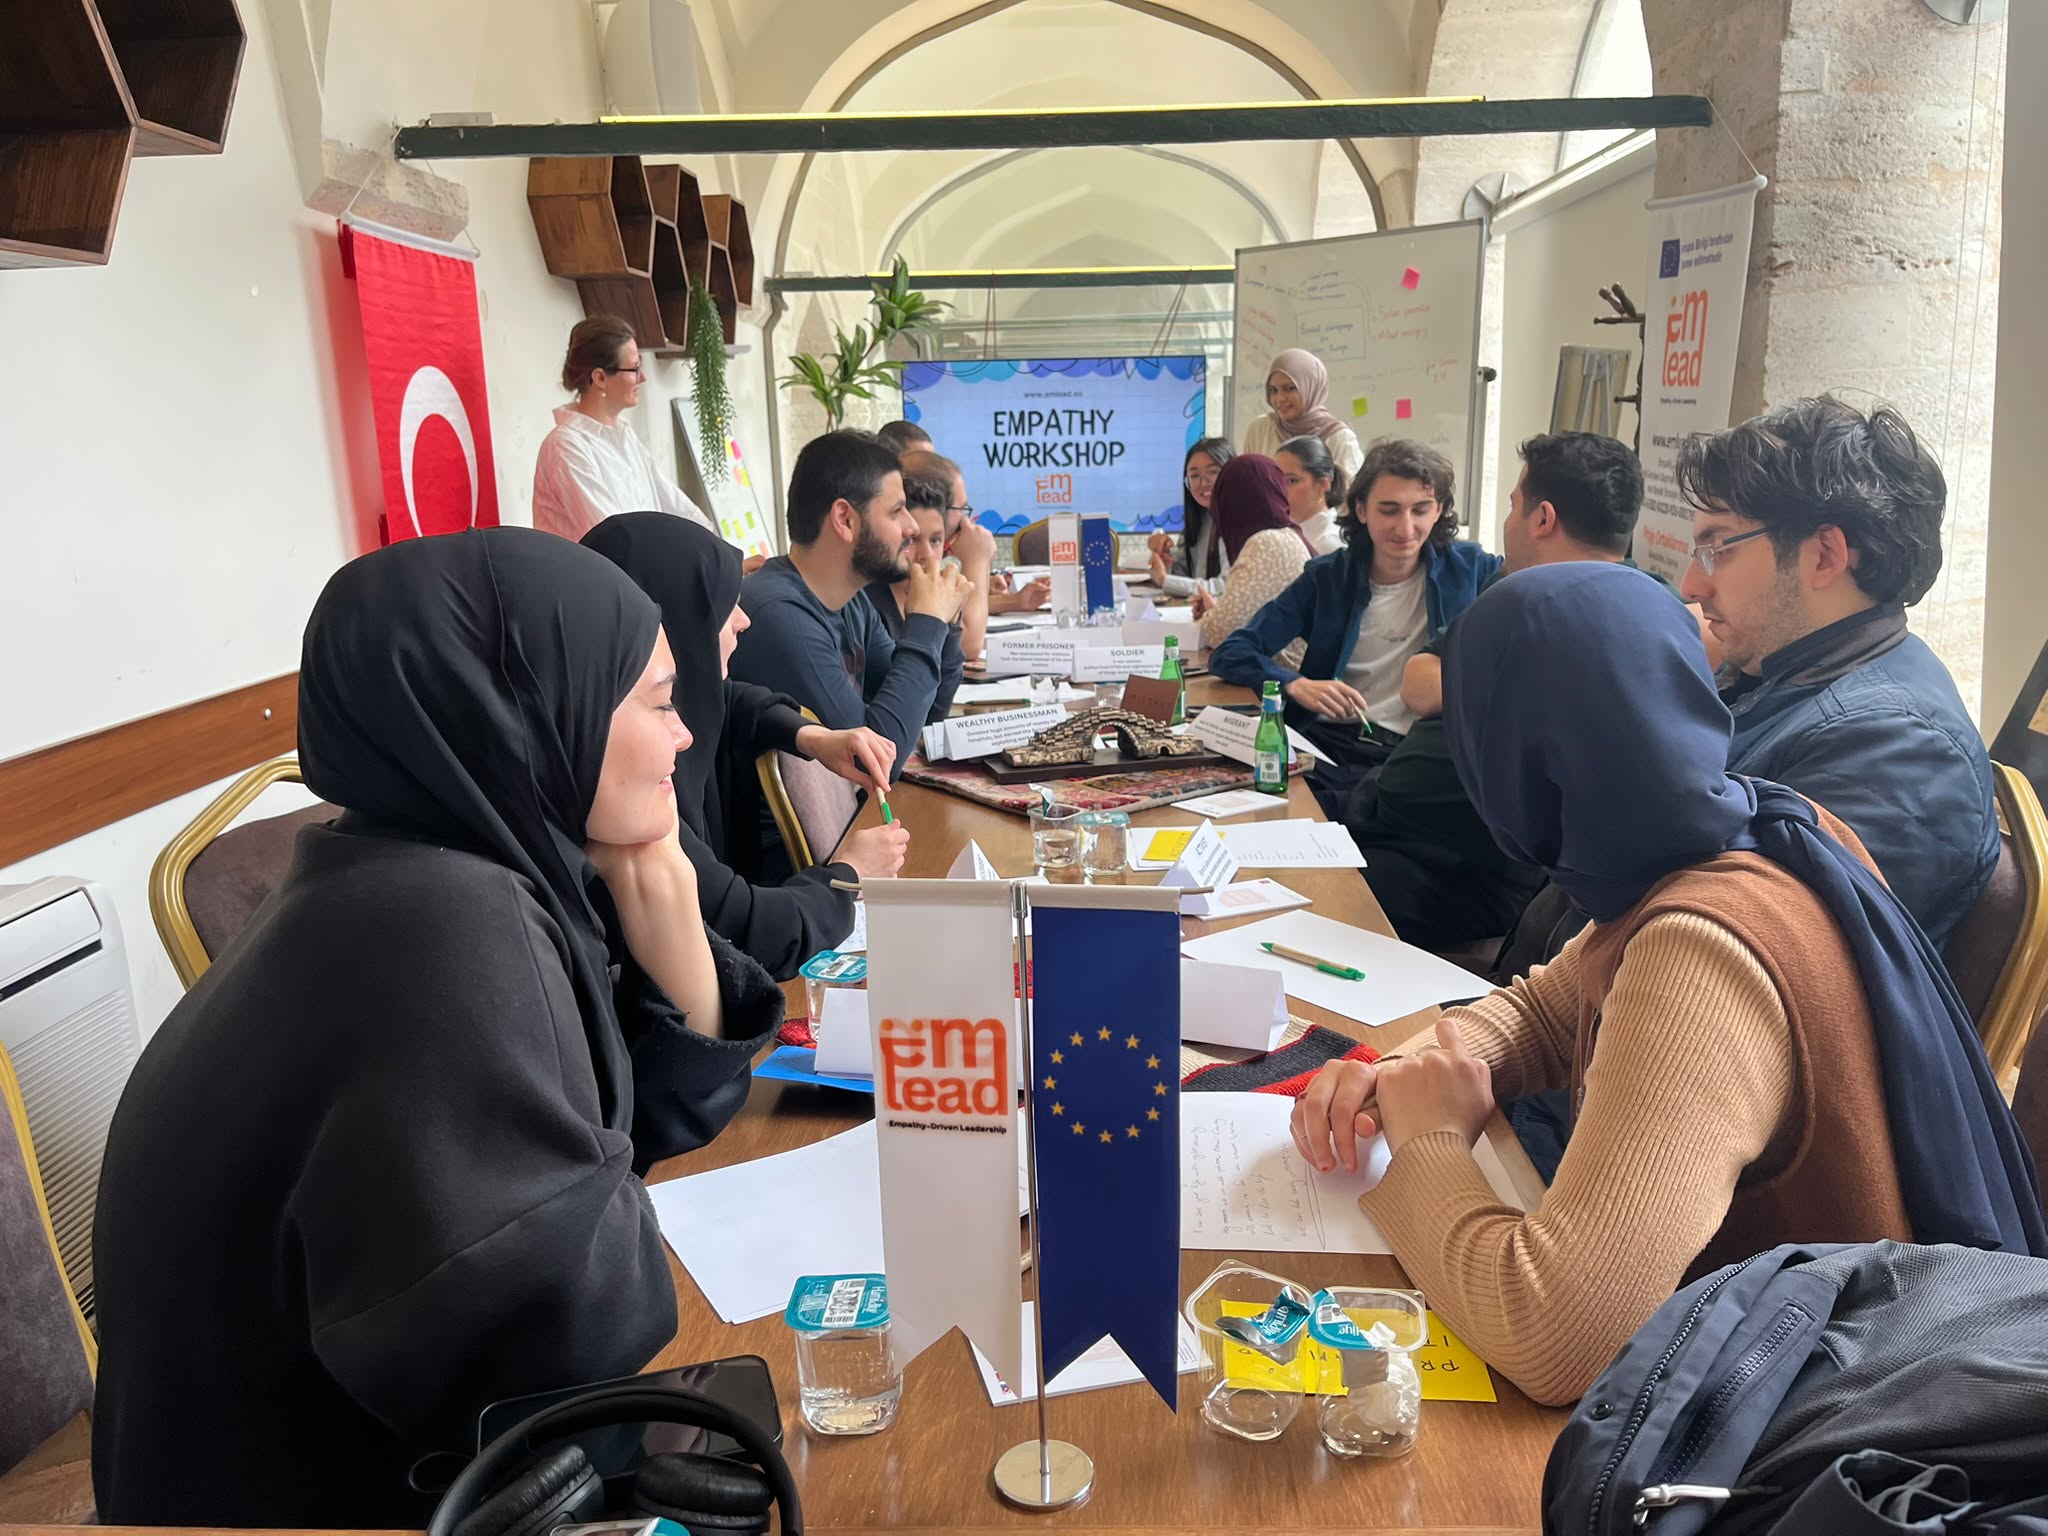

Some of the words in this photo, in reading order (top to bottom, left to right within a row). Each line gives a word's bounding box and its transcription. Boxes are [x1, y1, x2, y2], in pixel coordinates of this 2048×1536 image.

[993, 408, 1114, 437] EMPATHY
[982, 440, 1125, 468] WORKSHOP
[1003, 642, 1035, 650] FORMER
[1110, 649, 1145, 657] SOLDIER
[956, 716, 996, 729] WEALTHY
[997, 708, 1058, 723] BUSINESSMAN
[885, 1074, 1008, 1116] lead
[889, 1120, 959, 1131] Empathy-Driven
[960, 1124, 1007, 1135] Leadership
